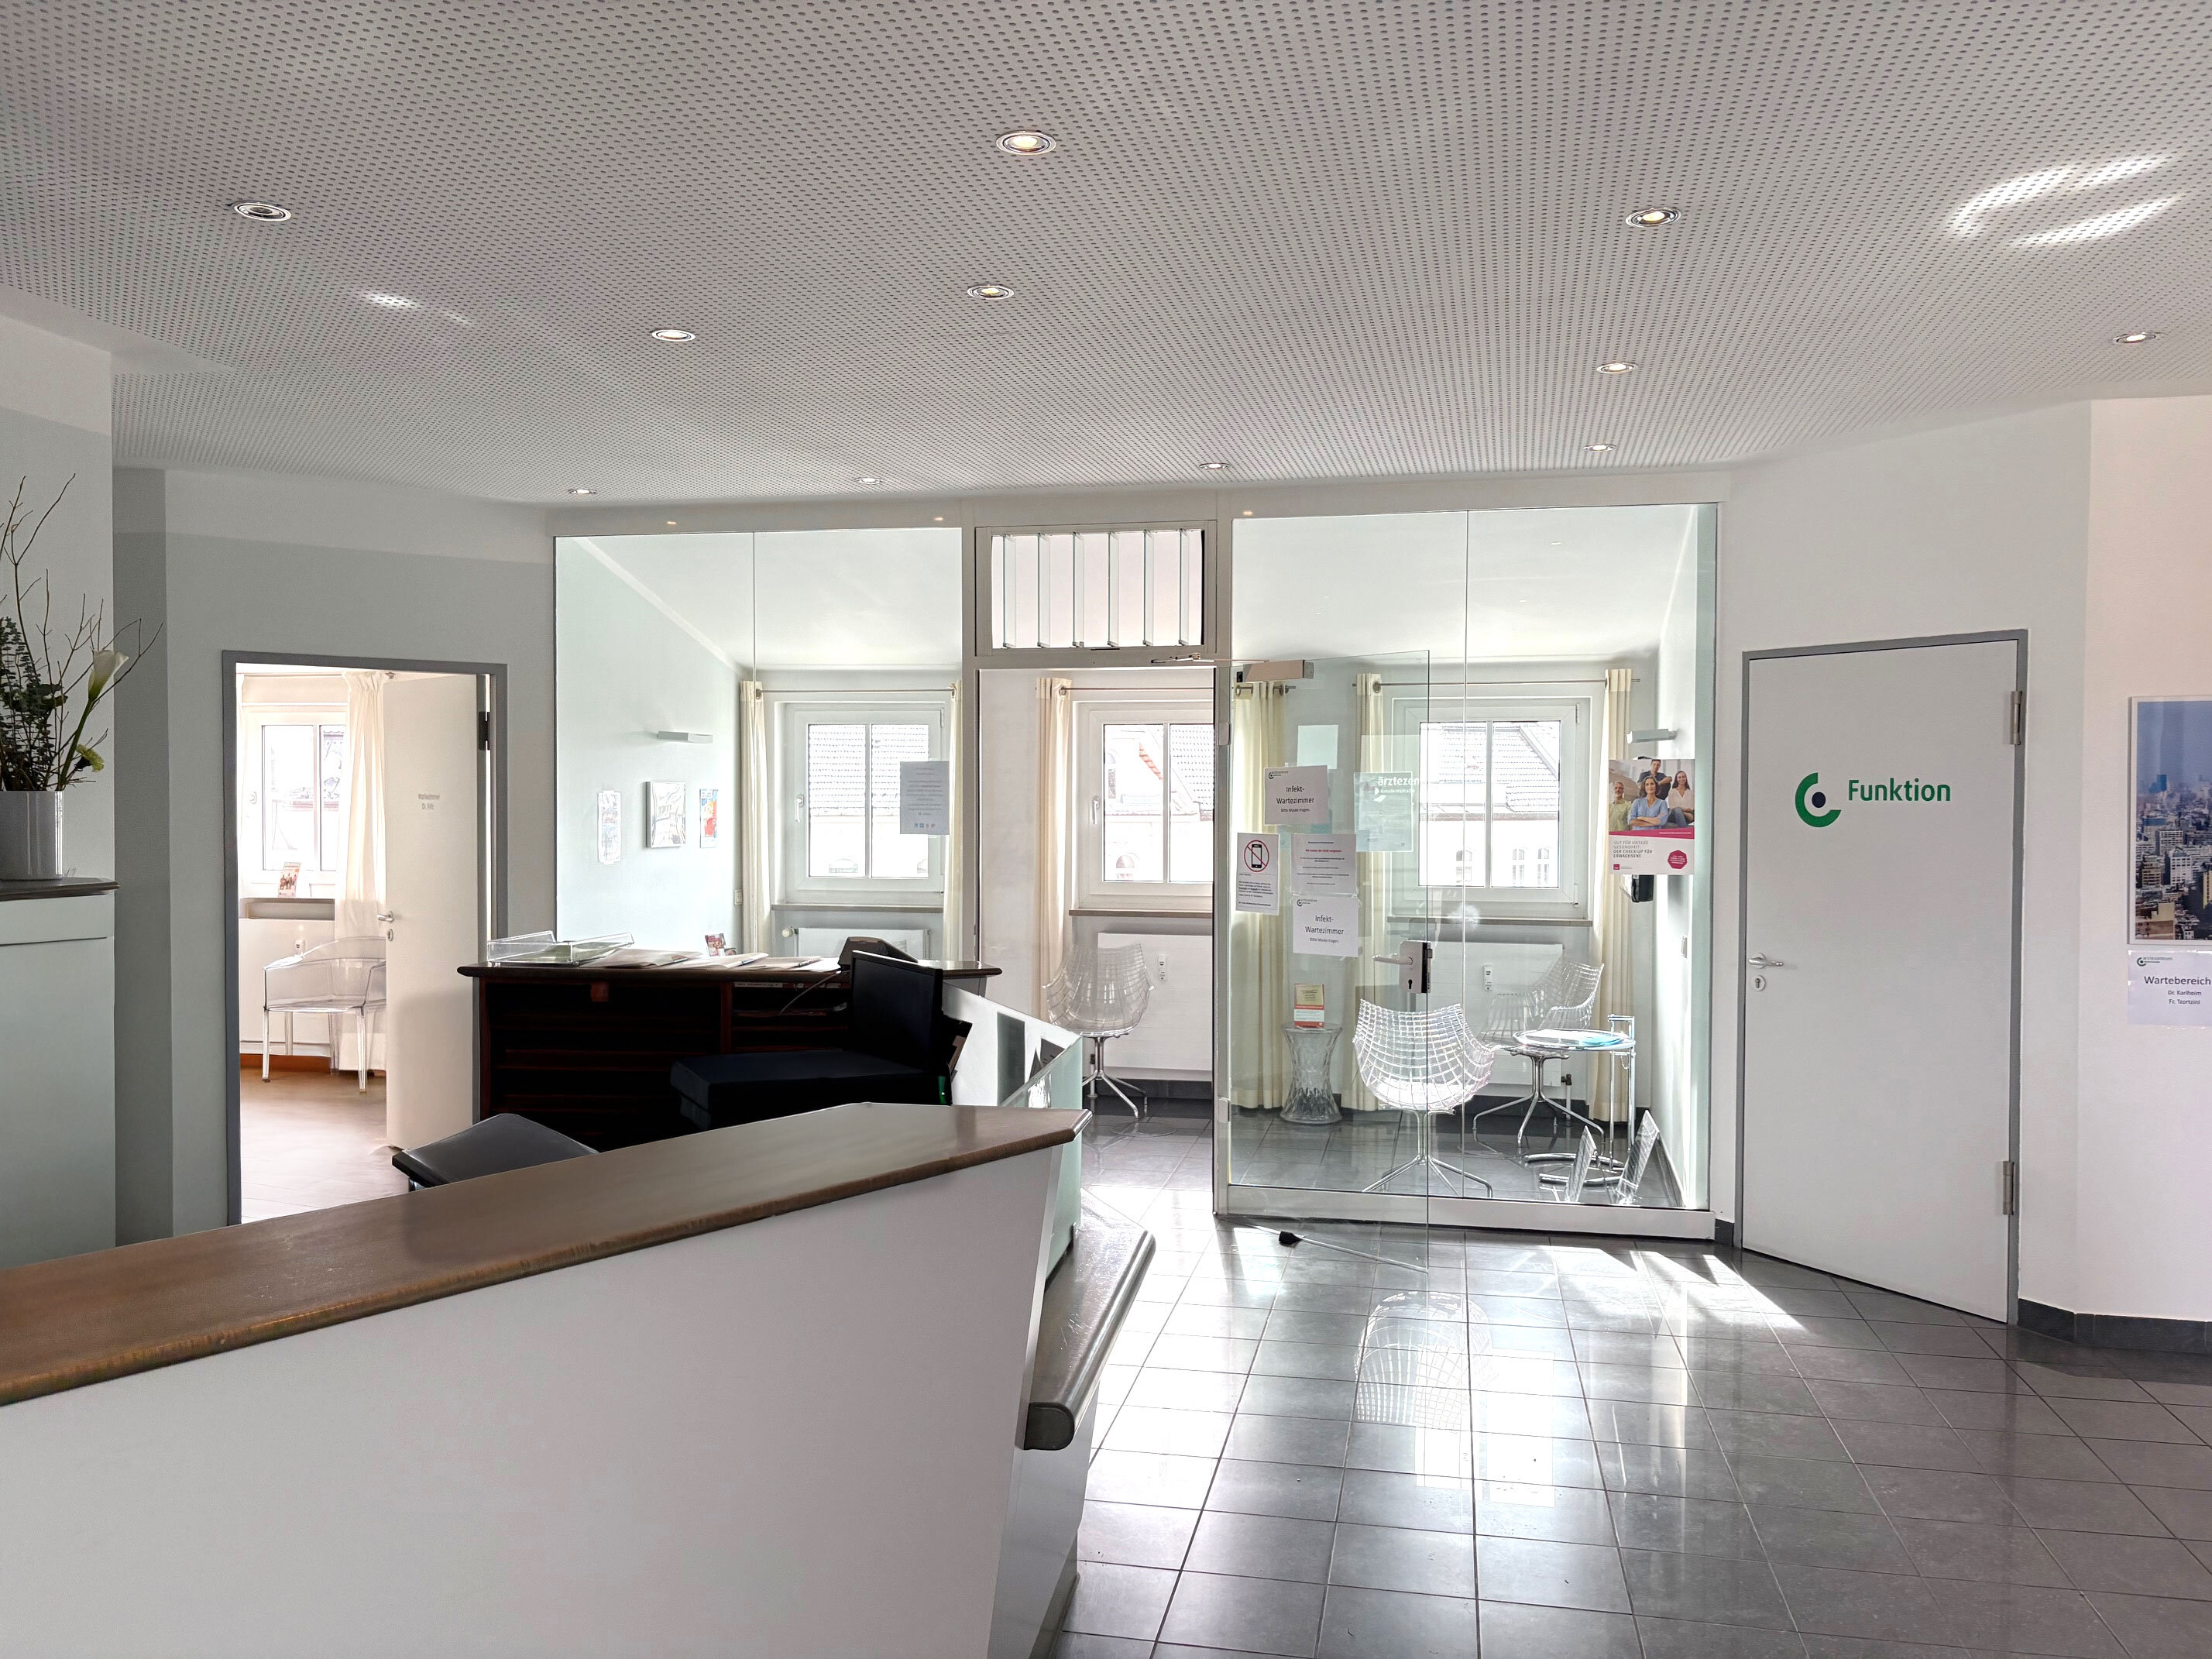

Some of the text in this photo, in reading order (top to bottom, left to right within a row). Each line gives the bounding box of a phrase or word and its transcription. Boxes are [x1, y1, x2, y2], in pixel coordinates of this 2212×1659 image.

[1848, 778, 1951, 801] Funktion
[1305, 926, 1344, 935] Wartezimmer
[2144, 976, 2211, 985] Wartebereich
